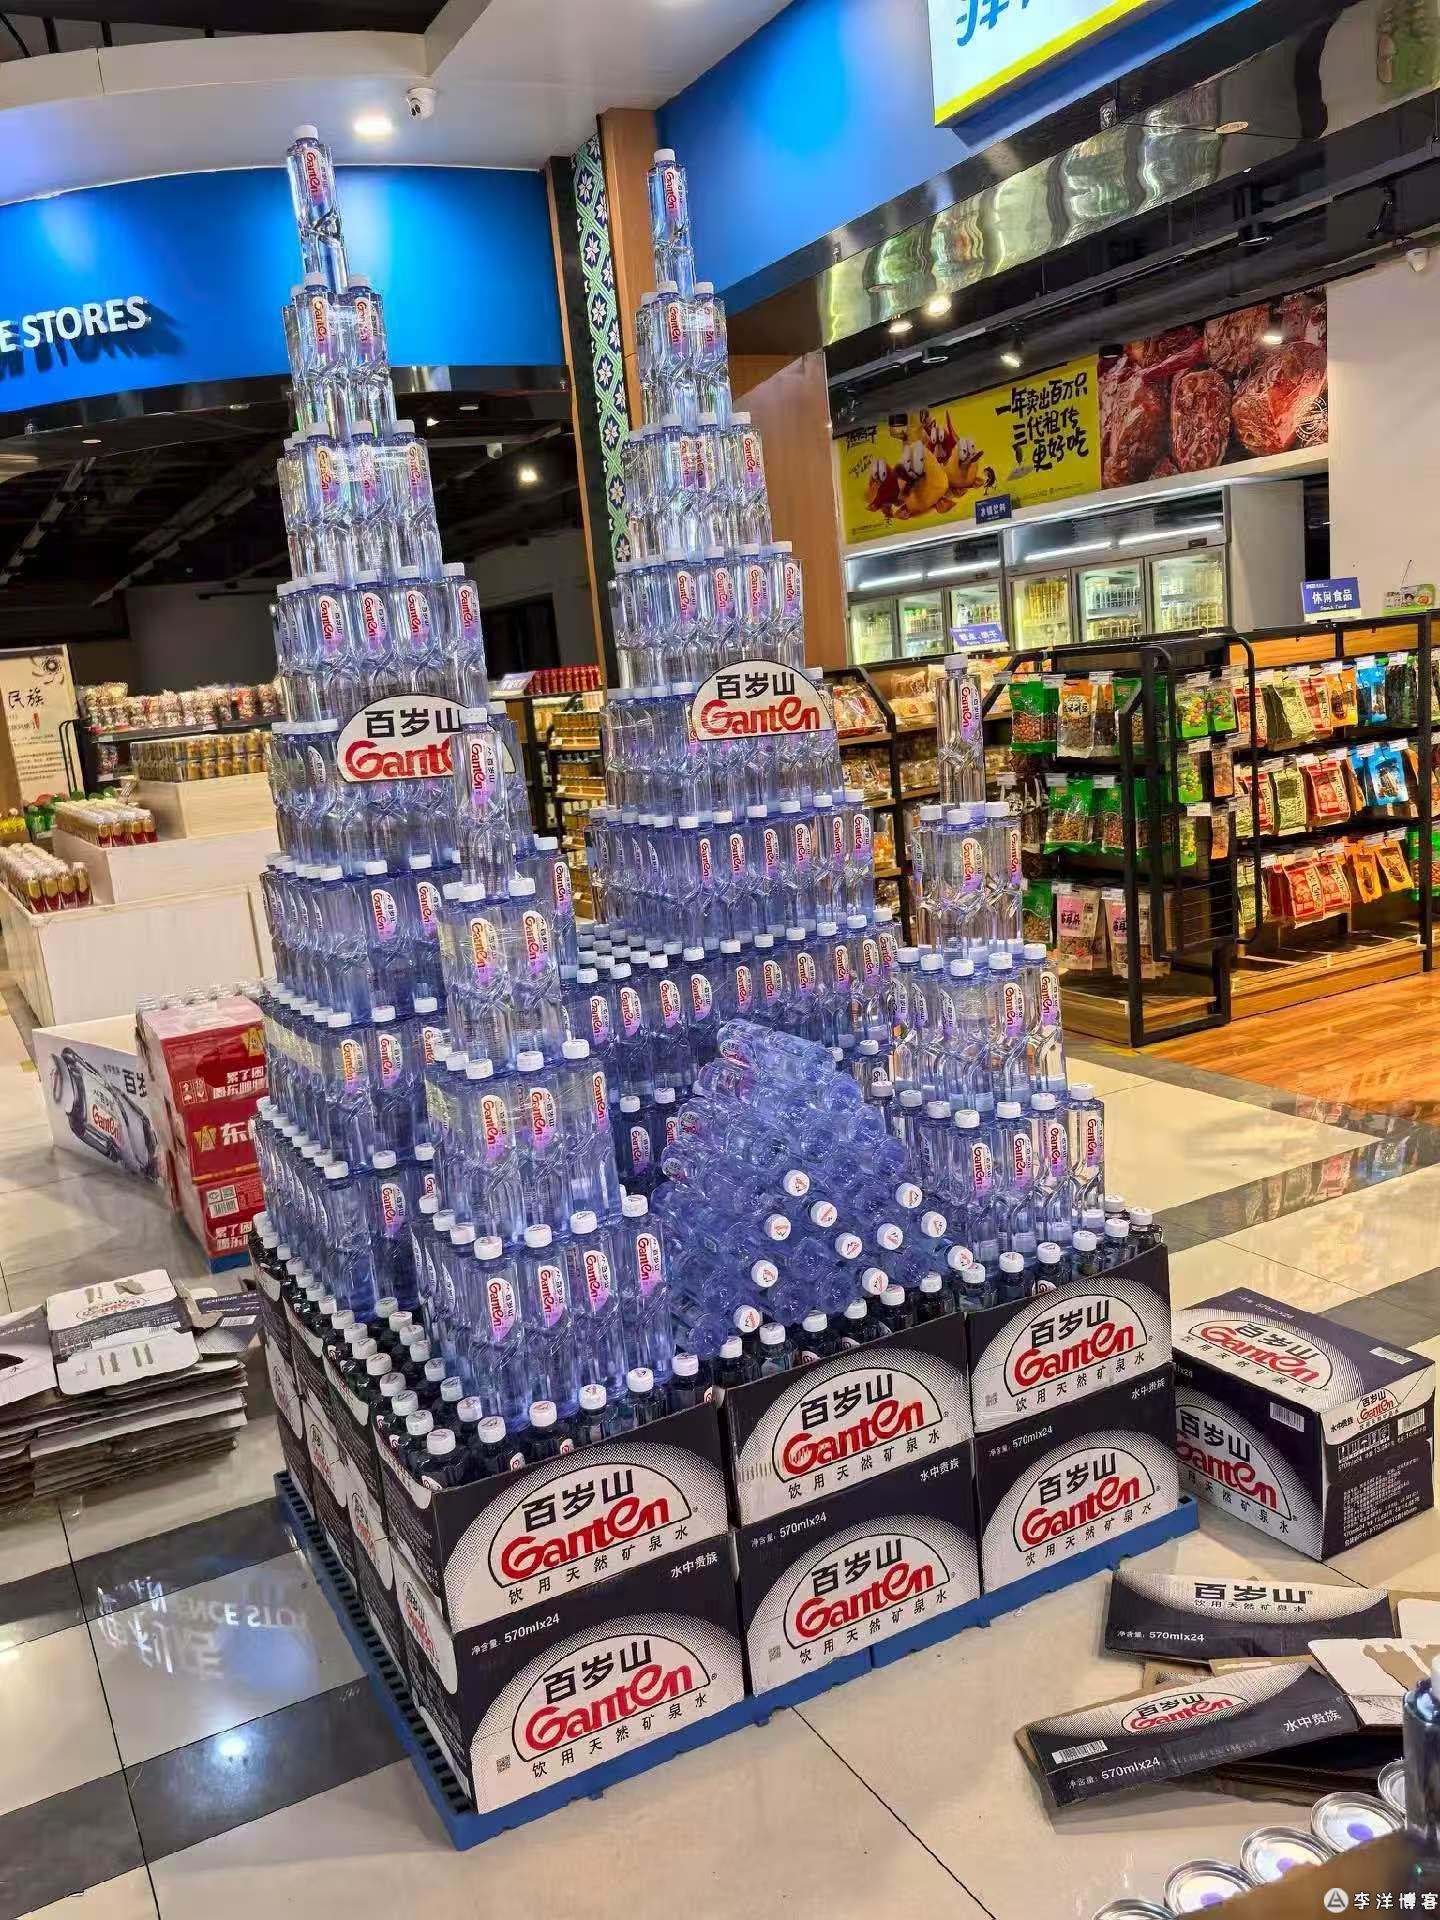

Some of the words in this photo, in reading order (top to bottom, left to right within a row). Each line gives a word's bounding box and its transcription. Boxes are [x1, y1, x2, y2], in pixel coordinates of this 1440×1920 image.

[22, 296, 146, 348] STORES
[996, 372, 1088, 418] 一年卖出百万只
[1013, 407, 1080, 442] 三代祖传
[1031, 427, 1089, 472] 更好吃
[8, 688, 45, 709] 民族
[716, 672, 796, 699] 百岁山
[365, 708, 460, 738] 百岁山
[700, 696, 820, 735] Ganten
[345, 740, 453, 780] Gant
[472, 743, 485, 789] Ganten
[586, 1255, 600, 1298] Ganten
[639, 1238, 652, 1280] Ganten
[489, 1283, 504, 1328] Ganten
[541, 1270, 555, 1313] Ganten
[1030, 1299, 1110, 1350] 百岁山
[1236, 1323, 1320, 1360] 百岁山
[1014, 1322, 1135, 1388] Ganten
[800, 1373, 894, 1431] 百岁山
[1015, 1350, 1146, 1414] 饮用天然矿泉水
[783, 1399, 925, 1476] Ganten
[1180, 1410, 1250, 1462] 百岁山
[788, 1429, 941, 1500] 饮用天然矿泉水
[920, 1457, 961, 1483] 水中贵族
[1038, 1452, 1117, 1506] 百岁山
[522, 1469, 635, 1533] 百岁山
[1022, 1476, 1141, 1545] Ganten
[501, 1497, 670, 1580] Ganten
[780, 1511, 828, 1539] 570mlx24
[1025, 1502, 1153, 1567] 饮用天然矿泉水
[508, 1525, 688, 1605] 饮用天然矿泉水
[671, 1552, 719, 1579] 水中贵族
[811, 1538, 903, 1598] 百岁山
[796, 1562, 934, 1638] Ganten
[1194, 1582, 1307, 1605] 百岁山
[1194, 1600, 1304, 1613] 饮用天然矿泉水
[504, 1612, 561, 1644] 570mlx24
[799, 1588, 948, 1665] 饮用天然矿泉水
[1149, 1631, 1205, 1643] 570mlx24
[543, 1639, 653, 1704] 百岁山
[525, 1664, 693, 1751] Ganten
[1137, 1694, 1205, 1718] 百岁山
[1283, 1709, 1342, 1732] 水中贵族
[532, 1692, 707, 1778] 饮用天然矿泉水
[1101, 1756, 1160, 1781] 570mlx24
